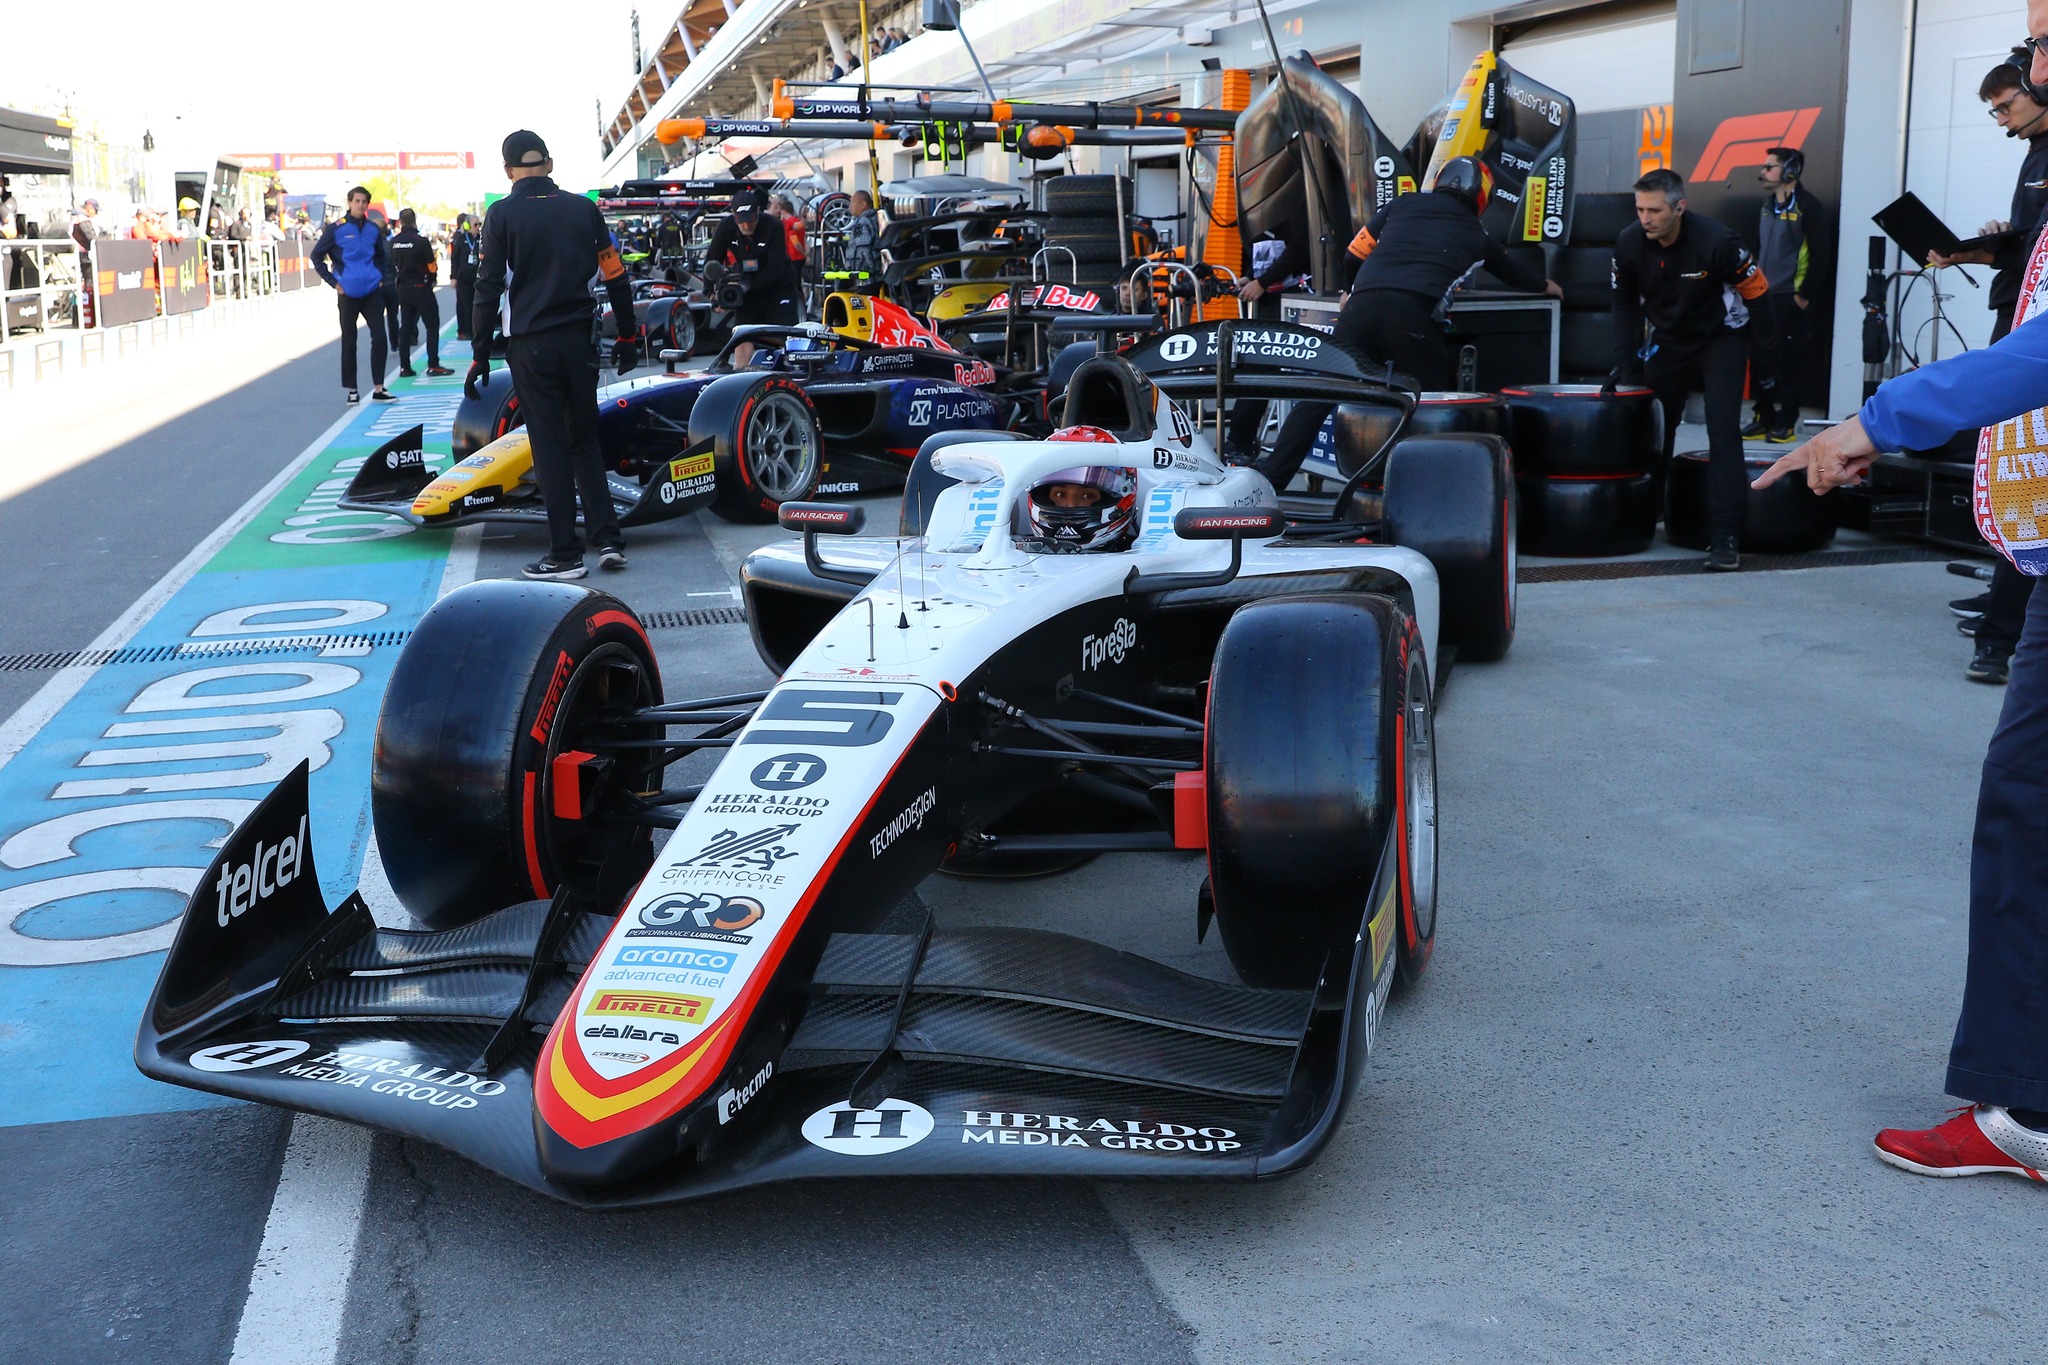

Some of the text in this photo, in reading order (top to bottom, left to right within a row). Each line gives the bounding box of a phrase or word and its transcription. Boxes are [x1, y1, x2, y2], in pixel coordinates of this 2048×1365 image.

[816, 104, 831, 113] DP
[736, 124, 770, 132] WORLD
[284, 156, 334, 168] Lenovo
[348, 155, 395, 167] Lenovo
[409, 154, 457, 167] Lenovo
[1546, 157, 1559, 214] HERALDO
[1555, 157, 1567, 215] MEDIA GROUP
[1528, 183, 1543, 236] PIRELLI
[1045, 284, 1101, 312] Bull
[1206, 344, 1318, 360] MIA GROUP
[954, 360, 996, 387] Red Bull
[674, 457, 711, 477] PIRELLI
[676, 473, 715, 490] HERALDO
[676, 483, 716, 500] MEDIA GROUP
[815, 482, 859, 494] INKER
[791, 511, 844, 521] IAN RACING
[1200, 518, 1267, 527] IAN RACING
[1082, 617, 1137, 672] Fipresta
[530, 650, 574, 746] PIRELLI
[703, 804, 823, 818] MEDIA GROUP
[710, 794, 830, 808] HERALDO
[869, 785, 936, 860] TECHNODESIGN
[215, 813, 308, 927] telcel
[662, 868, 786, 885] GRIFFINCORE
[671, 879, 765, 890] SOLUTIONS
[628, 929, 749, 945] PERFORMANCE LUBRICATION
[620, 949, 728, 970] aramco
[603, 969, 726, 989] advanced fuel
[595, 994, 701, 1018] PIRELLI
[583, 1024, 680, 1046] dallara
[307, 1050, 507, 1096] HERALDO
[278, 1063, 479, 1111] MEDIA GROUP
[962, 1110, 1238, 1139] HERALDO
[961, 1128, 1243, 1152] MEDIA GROUP
